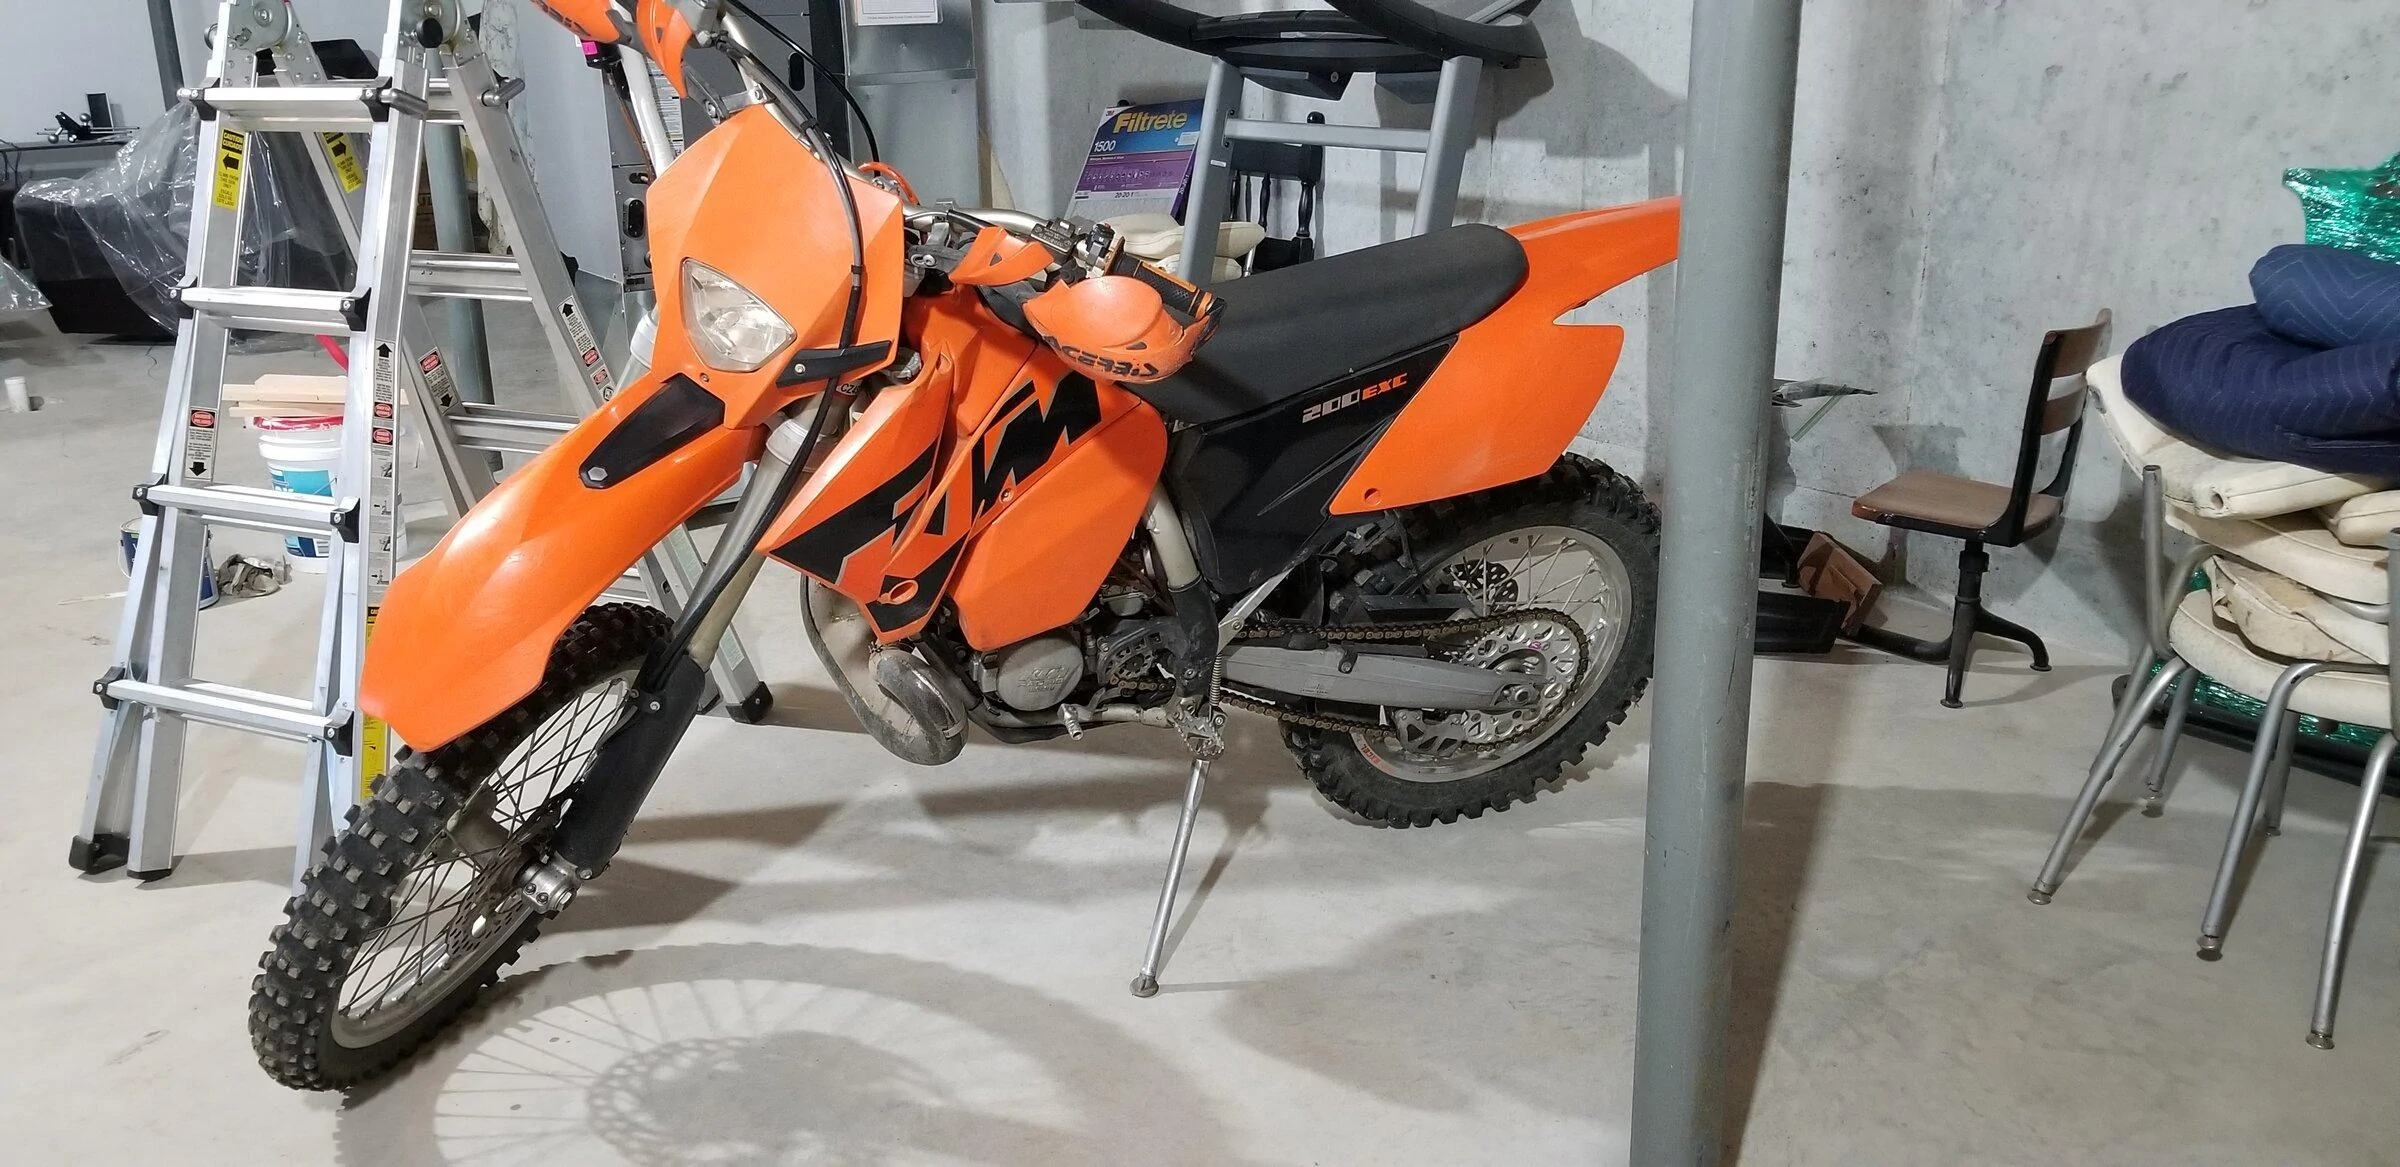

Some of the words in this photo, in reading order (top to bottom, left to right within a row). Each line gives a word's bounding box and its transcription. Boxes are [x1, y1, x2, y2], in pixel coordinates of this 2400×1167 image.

[1112, 111, 1188, 134] Filtrete
[1093, 140, 1116, 152] 1500
[1302, 388, 1361, 424] 200
[1362, 373, 1408, 401] EXC
